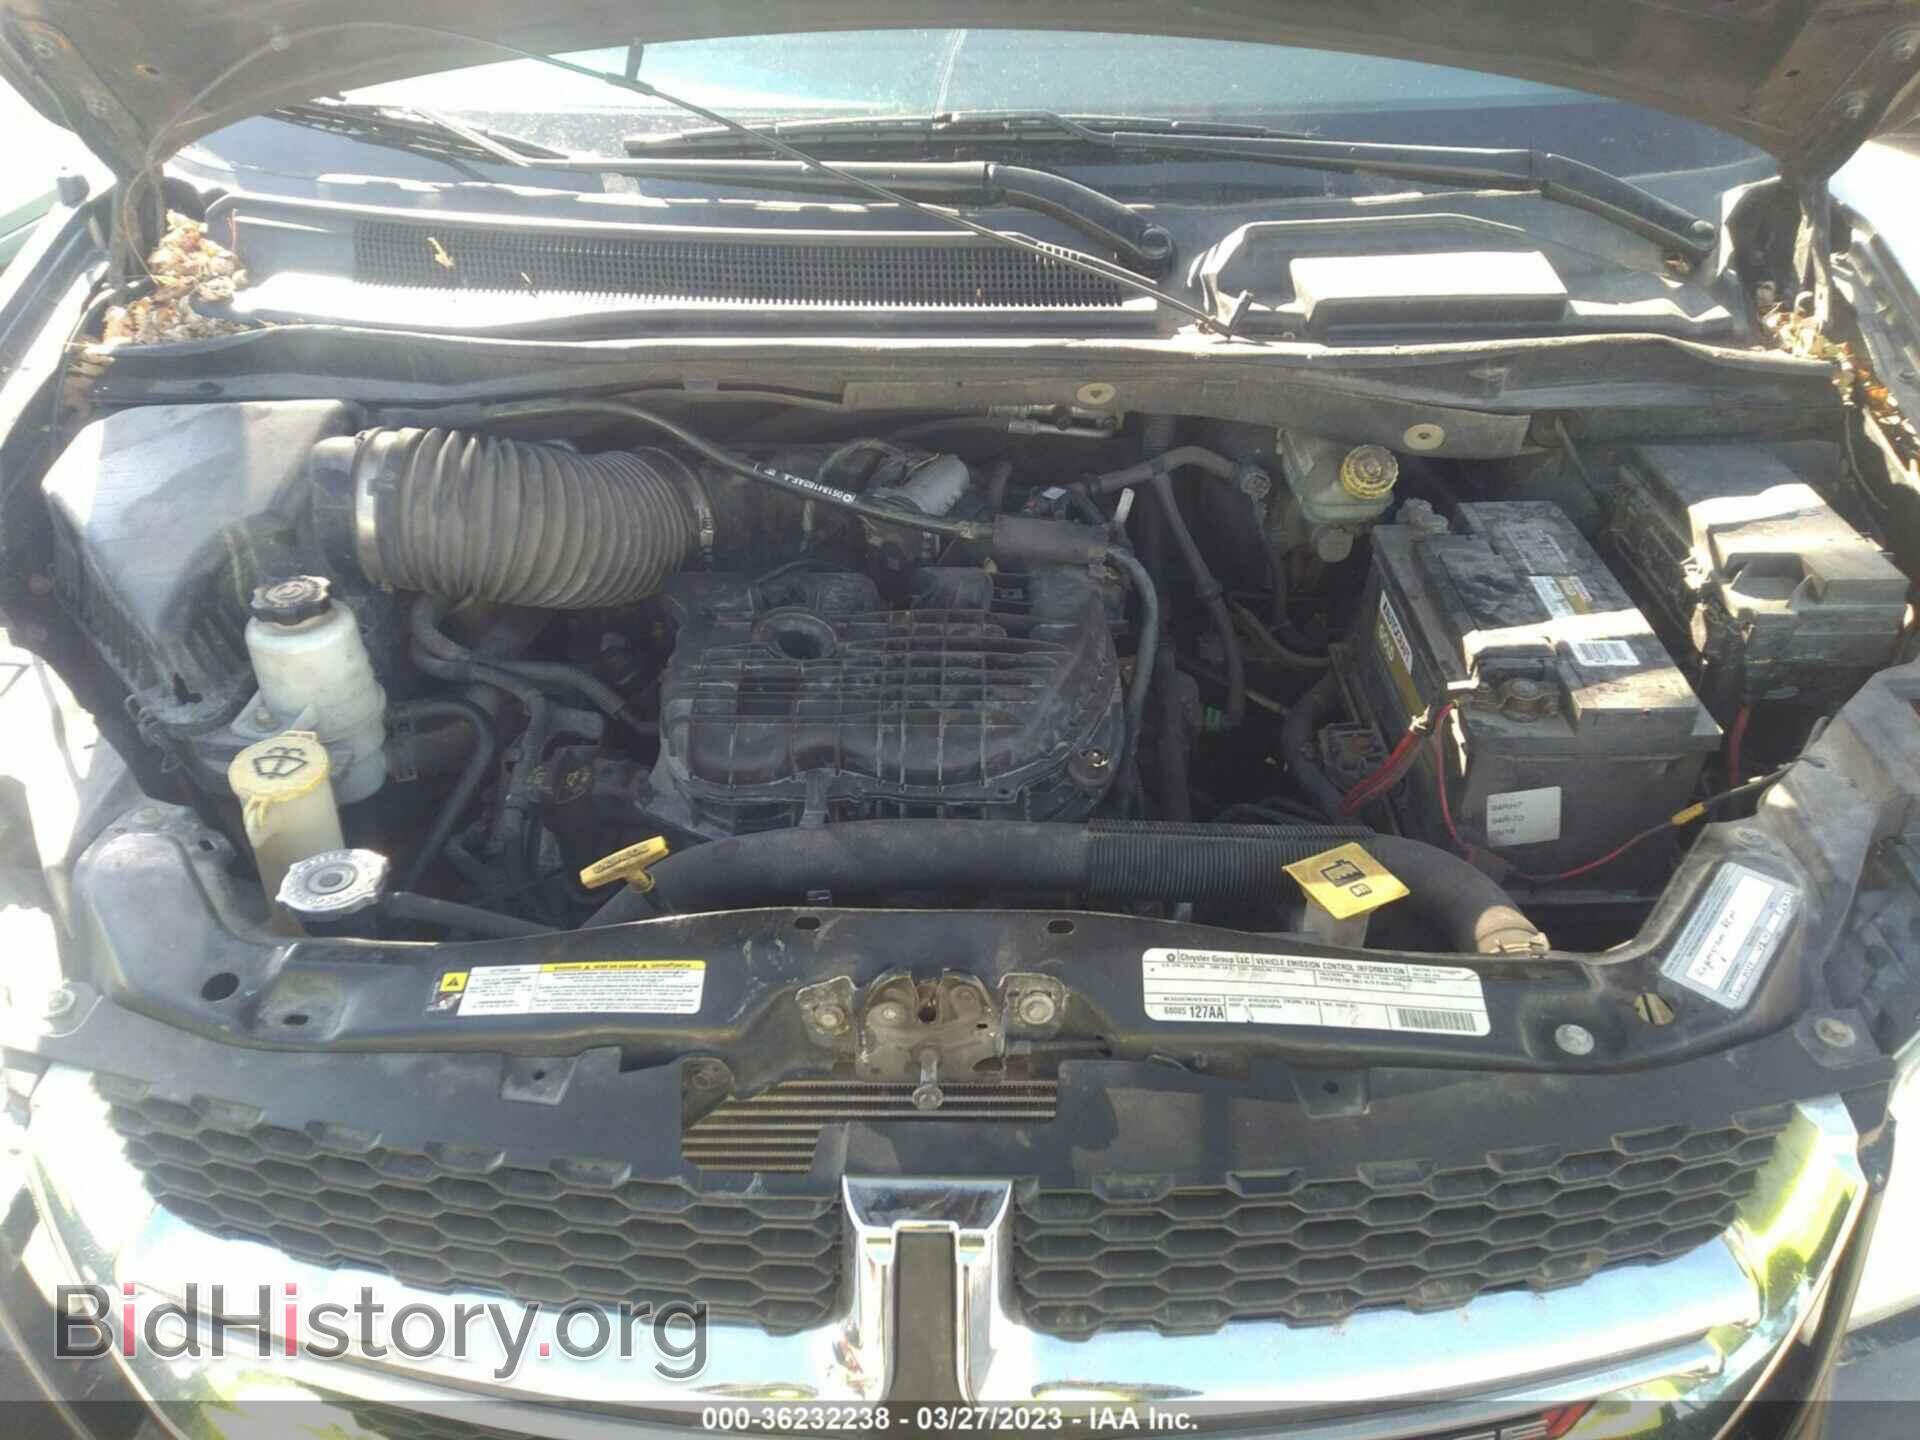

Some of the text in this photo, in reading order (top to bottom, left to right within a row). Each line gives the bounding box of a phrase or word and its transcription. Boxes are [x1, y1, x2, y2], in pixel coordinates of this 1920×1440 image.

[1179, 952, 1251, 966] Chrysler Group LLC
[1256, 957, 1284, 968] VEHICLE
[1286, 959, 1321, 970] EMISSION
[1322, 961, 1355, 972] CONTROL
[1356, 963, 1405, 975] INFORMATION
[1189, 1006, 1225, 1020] 127AA
